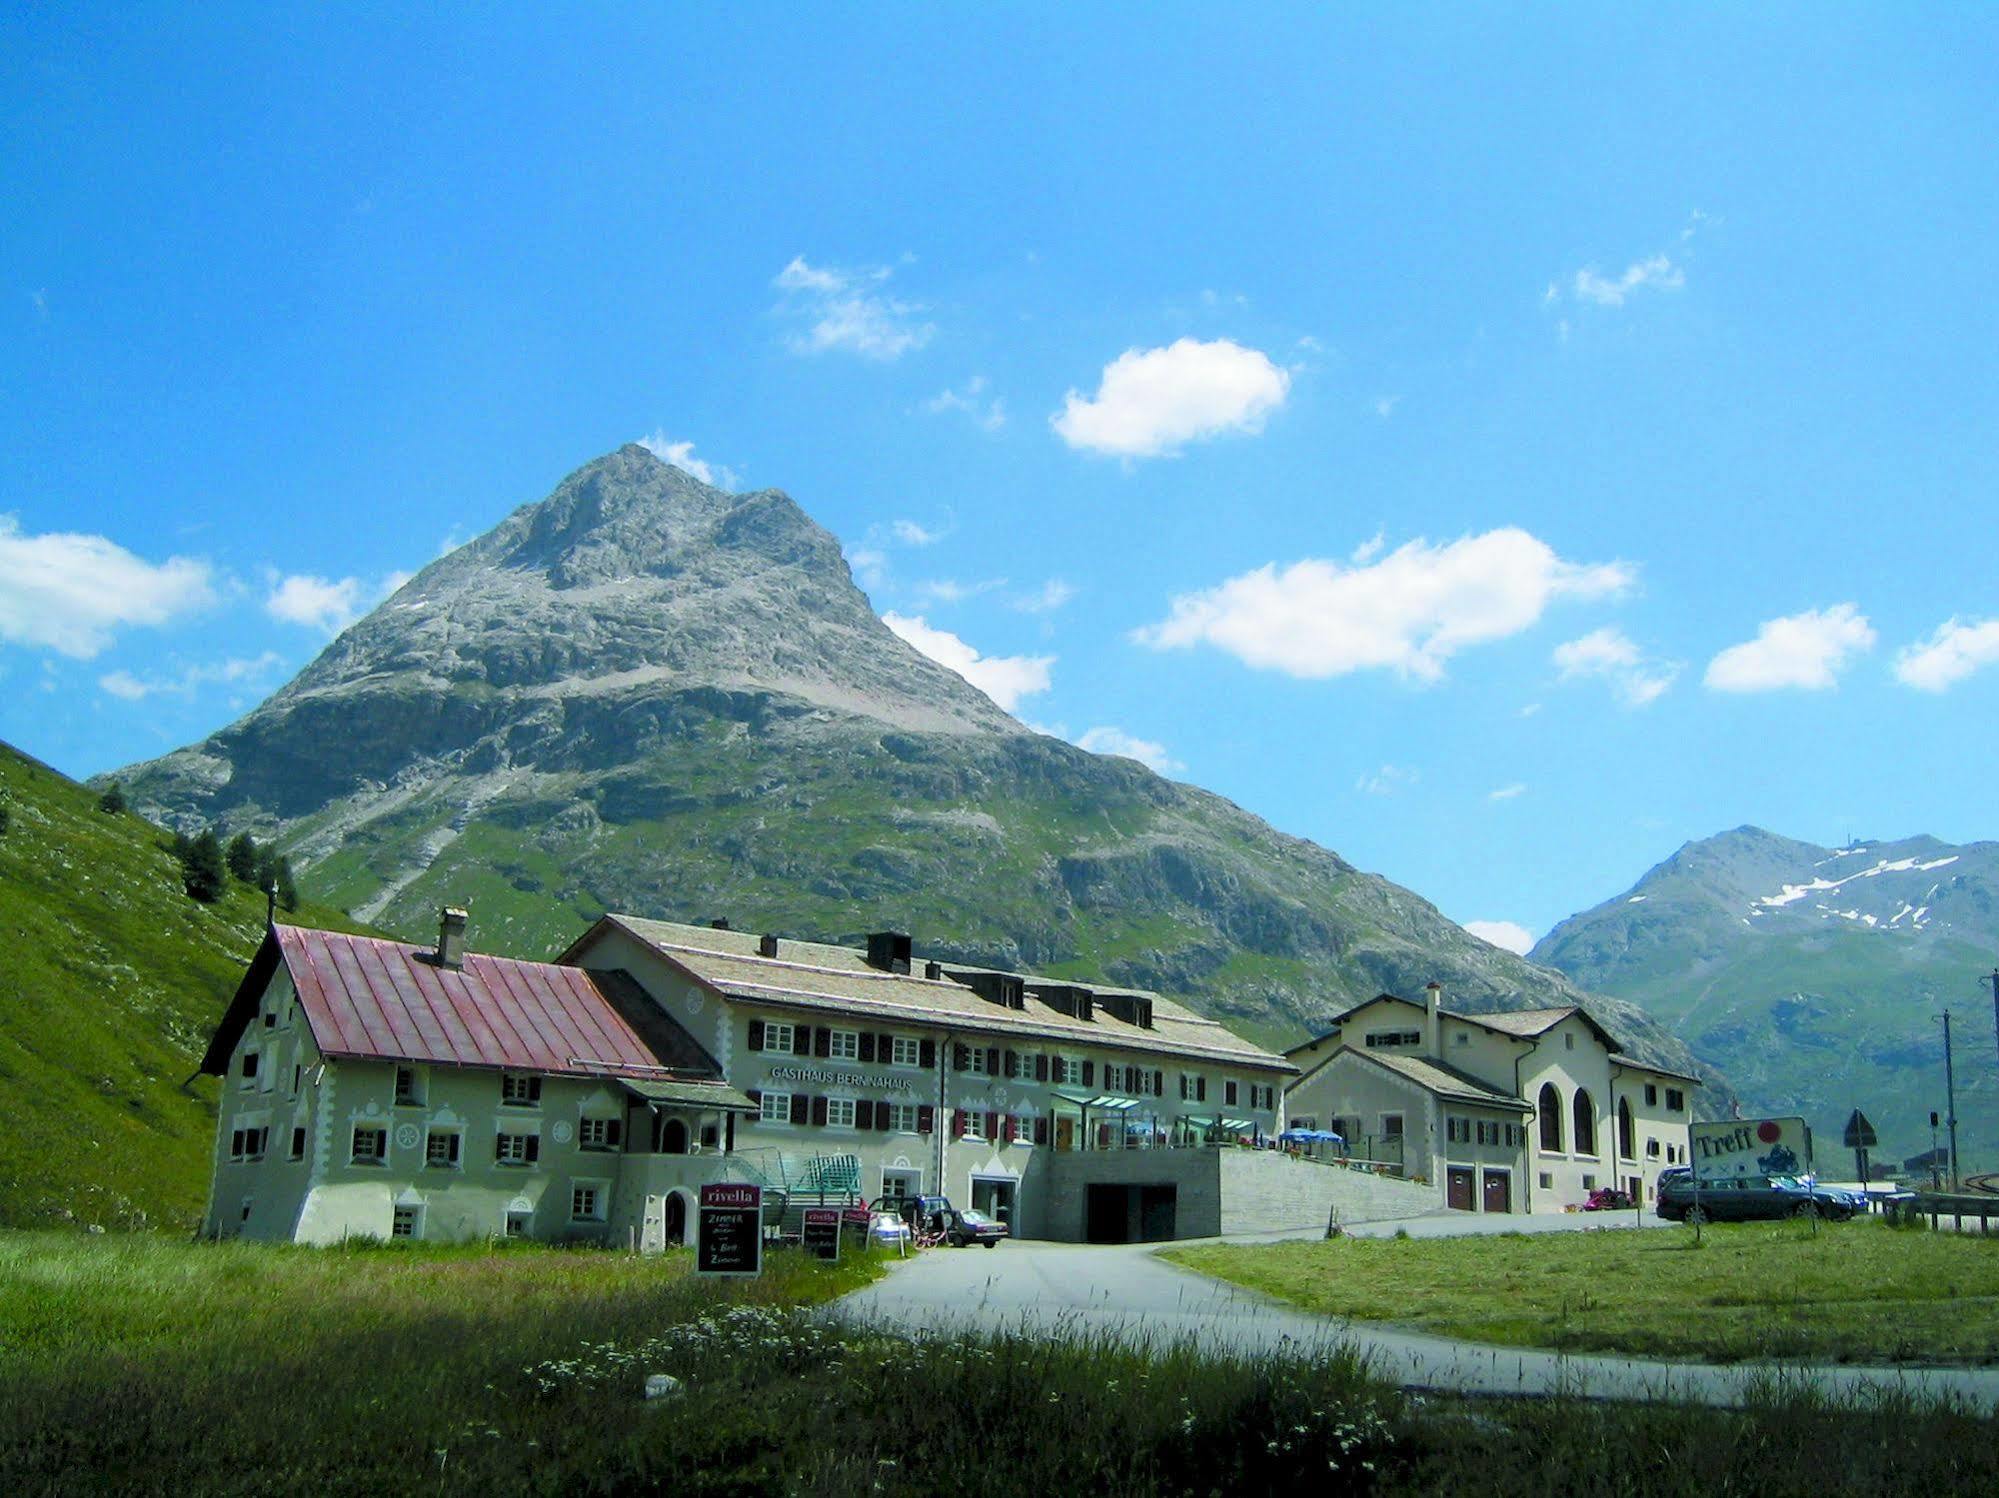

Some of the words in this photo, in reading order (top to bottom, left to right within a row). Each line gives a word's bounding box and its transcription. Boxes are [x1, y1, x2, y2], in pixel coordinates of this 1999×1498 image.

[772, 1066, 834, 1083] GASTHAUS
[1696, 1127, 1753, 1158] Treff
[708, 1189, 753, 1202] rivella
